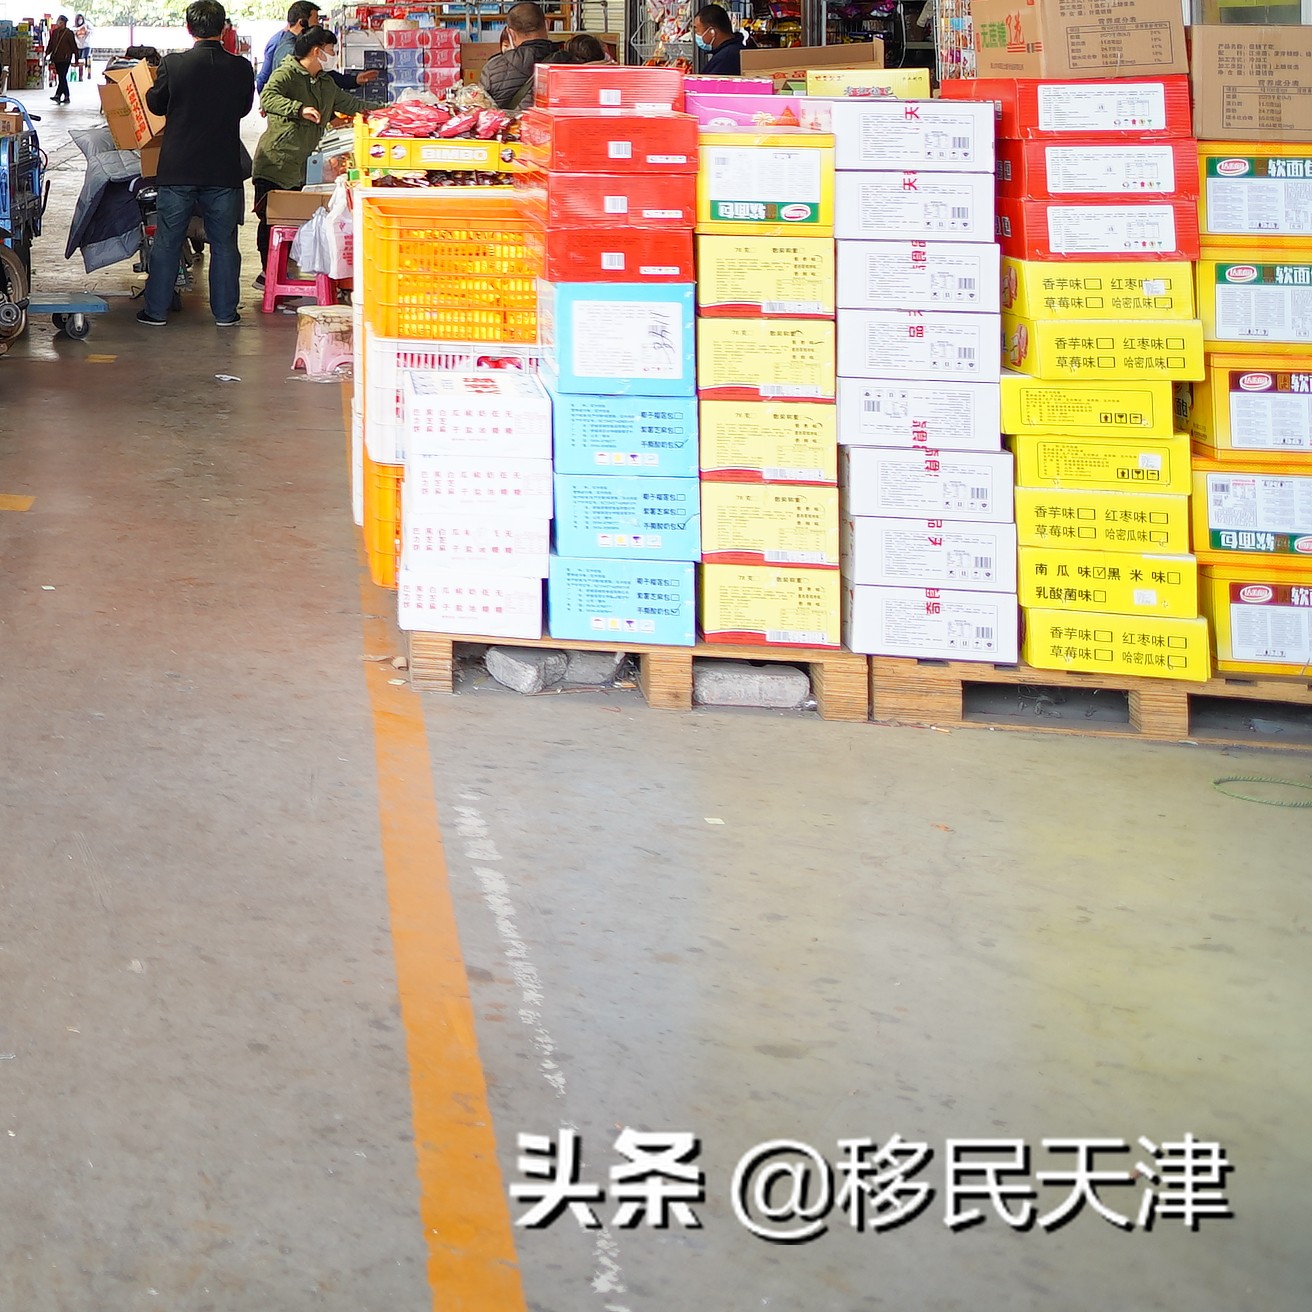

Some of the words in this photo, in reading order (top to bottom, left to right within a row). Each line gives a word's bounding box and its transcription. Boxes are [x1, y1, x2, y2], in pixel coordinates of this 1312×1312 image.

[421, 148, 488, 160] BIMBO
[1276, 266, 1312, 284] 软面
[1043, 278, 1082, 290] 香芋味
[1044, 297, 1084, 309] 草莓味
[1112, 298, 1152, 309] 哈密瓜味
[1054, 337, 1095, 350] 香芋味
[1123, 337, 1163, 350] 红枣味
[1056, 356, 1096, 369] 草莓味
[1124, 356, 1165, 369] 哈密瓜味
[1291, 373, 1312, 392] 软
[1034, 506, 1075, 519] 香芋味
[1105, 509, 1147, 523] 红枣味
[1035, 525, 1076, 538] 草莓味
[1104, 529, 1148, 542] 哈密瓜味
[1036, 586, 1092, 602] 乳酸菌味
[1291, 586, 1312, 605] 软
[1050, 626, 1092, 642] 香芋味
[1122, 632, 1165, 647] 红枣味
[1050, 645, 1092, 660] 草莓味
[1122, 651, 1166, 667] 哈密瓜味
